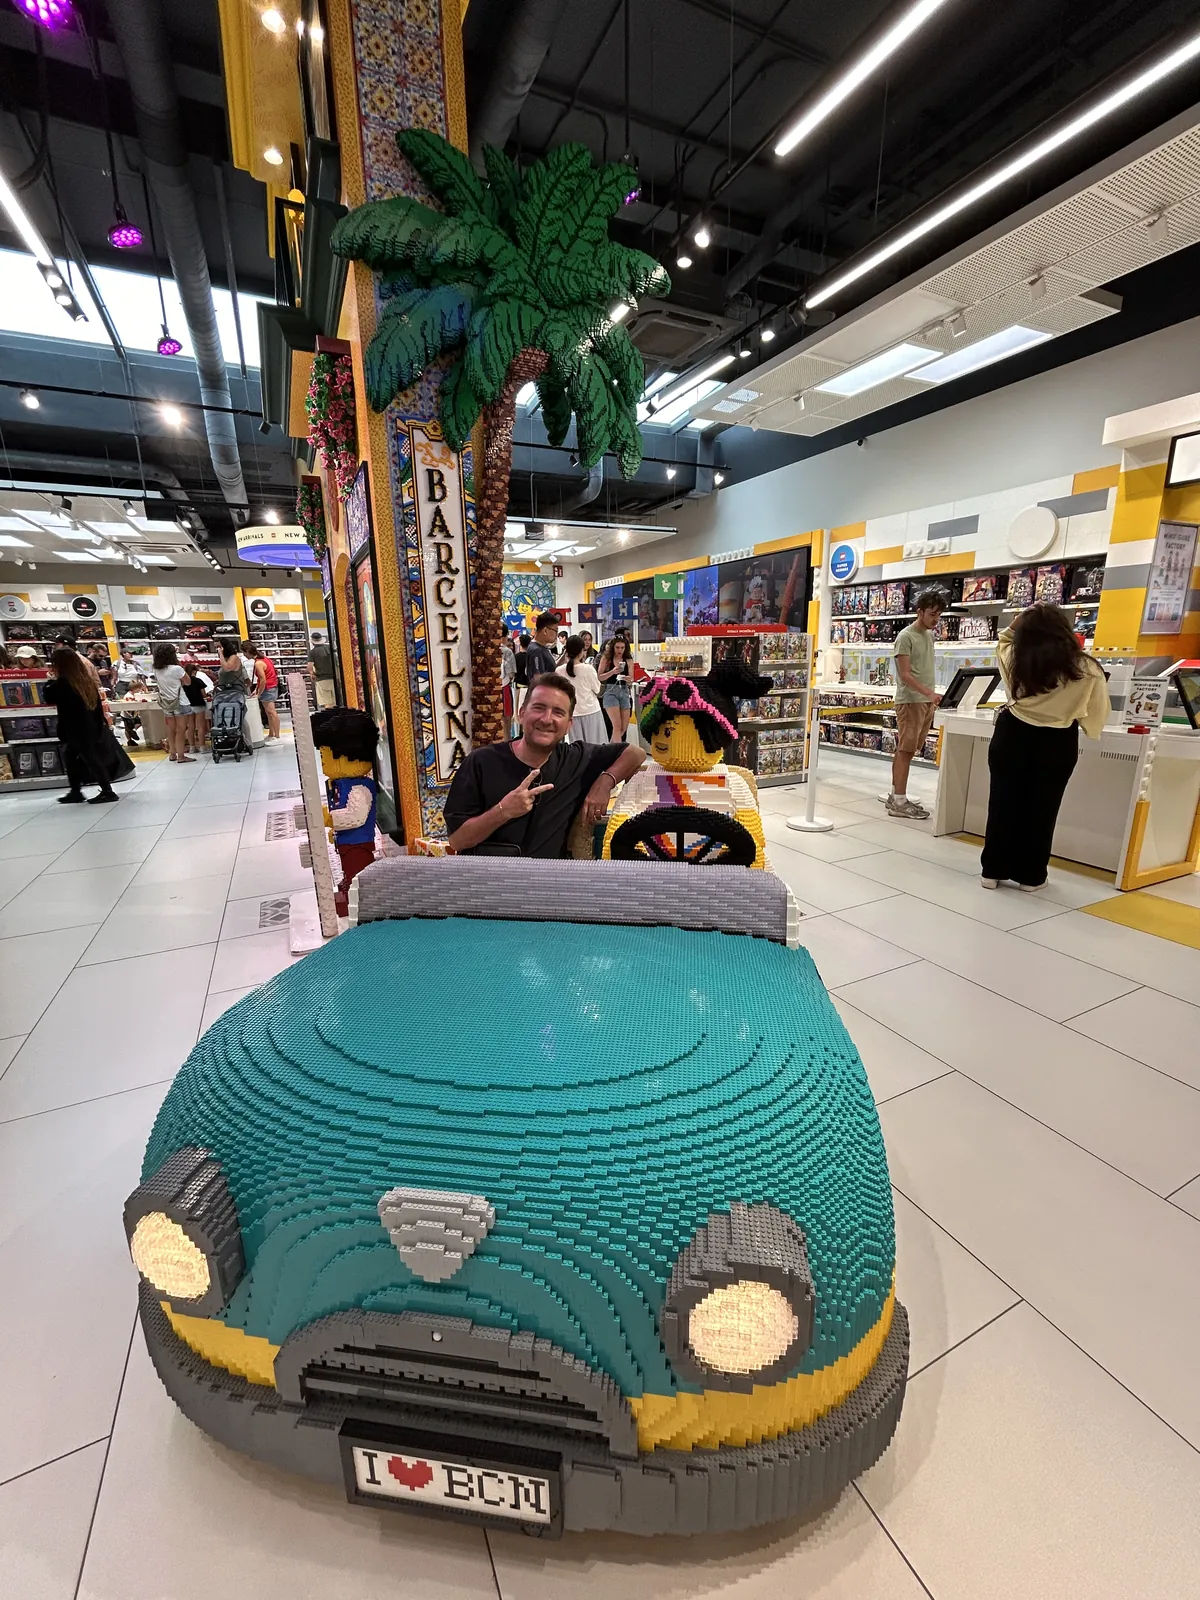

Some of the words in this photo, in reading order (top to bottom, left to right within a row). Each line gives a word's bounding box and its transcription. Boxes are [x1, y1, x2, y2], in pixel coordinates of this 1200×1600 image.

[1165, 542, 1186, 550] FACTORY
[426, 468, 469, 769] BARCELONA
[361, 1450, 382, 1486] I
[441, 1463, 548, 1515] BCN
